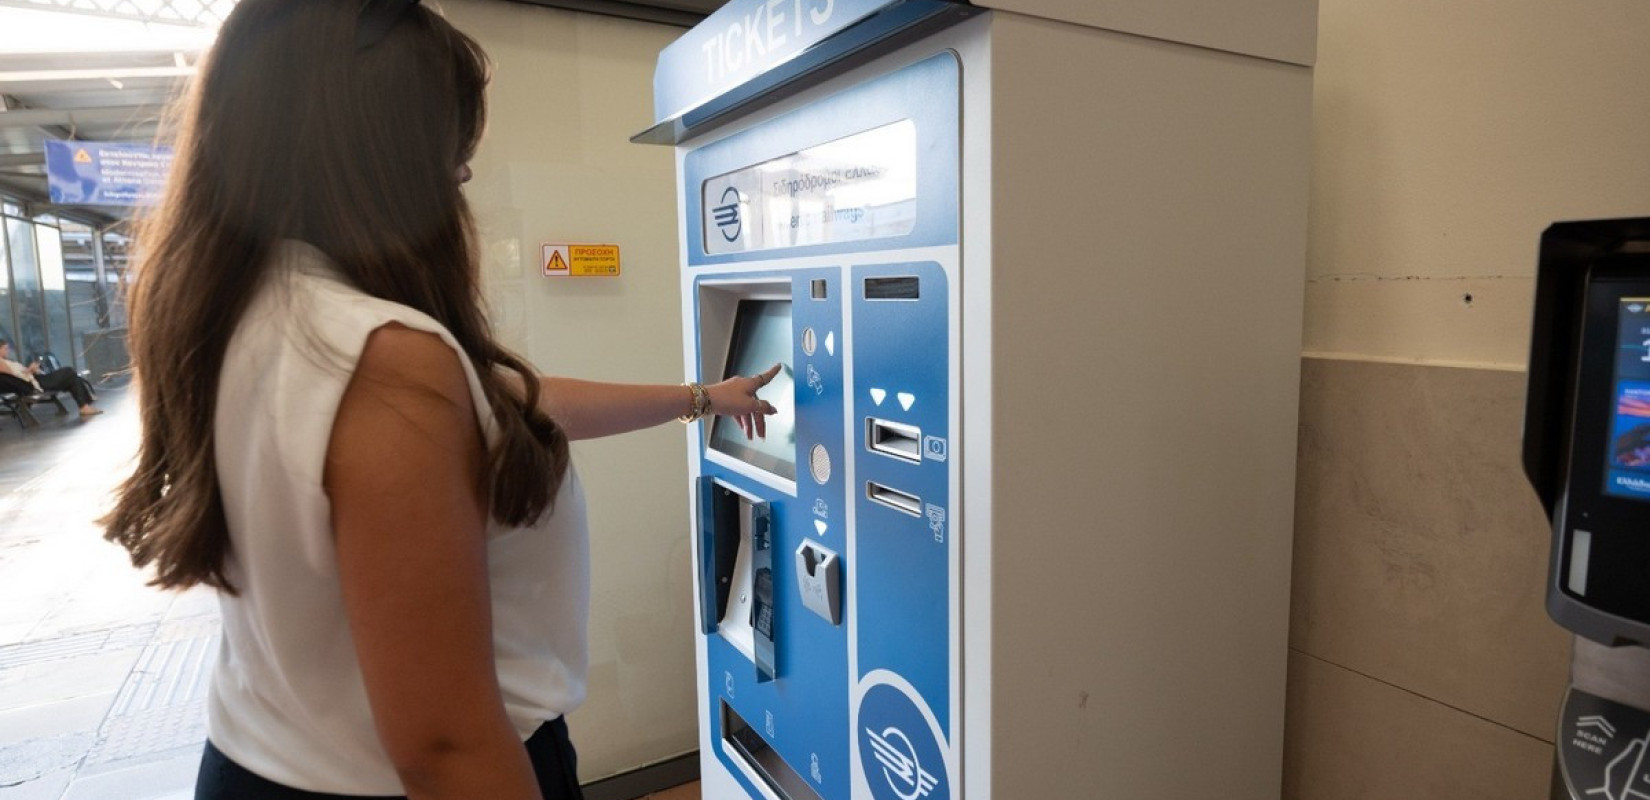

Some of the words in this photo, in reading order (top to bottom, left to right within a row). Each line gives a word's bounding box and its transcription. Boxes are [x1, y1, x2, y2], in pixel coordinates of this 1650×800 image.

[702, 0, 834, 84] TICKETS
[574, 248, 614, 257] ΠΡΟΣΟΧΗ
[1576, 729, 1606, 746] SCAN
[1573, 738, 1602, 755] HERE
